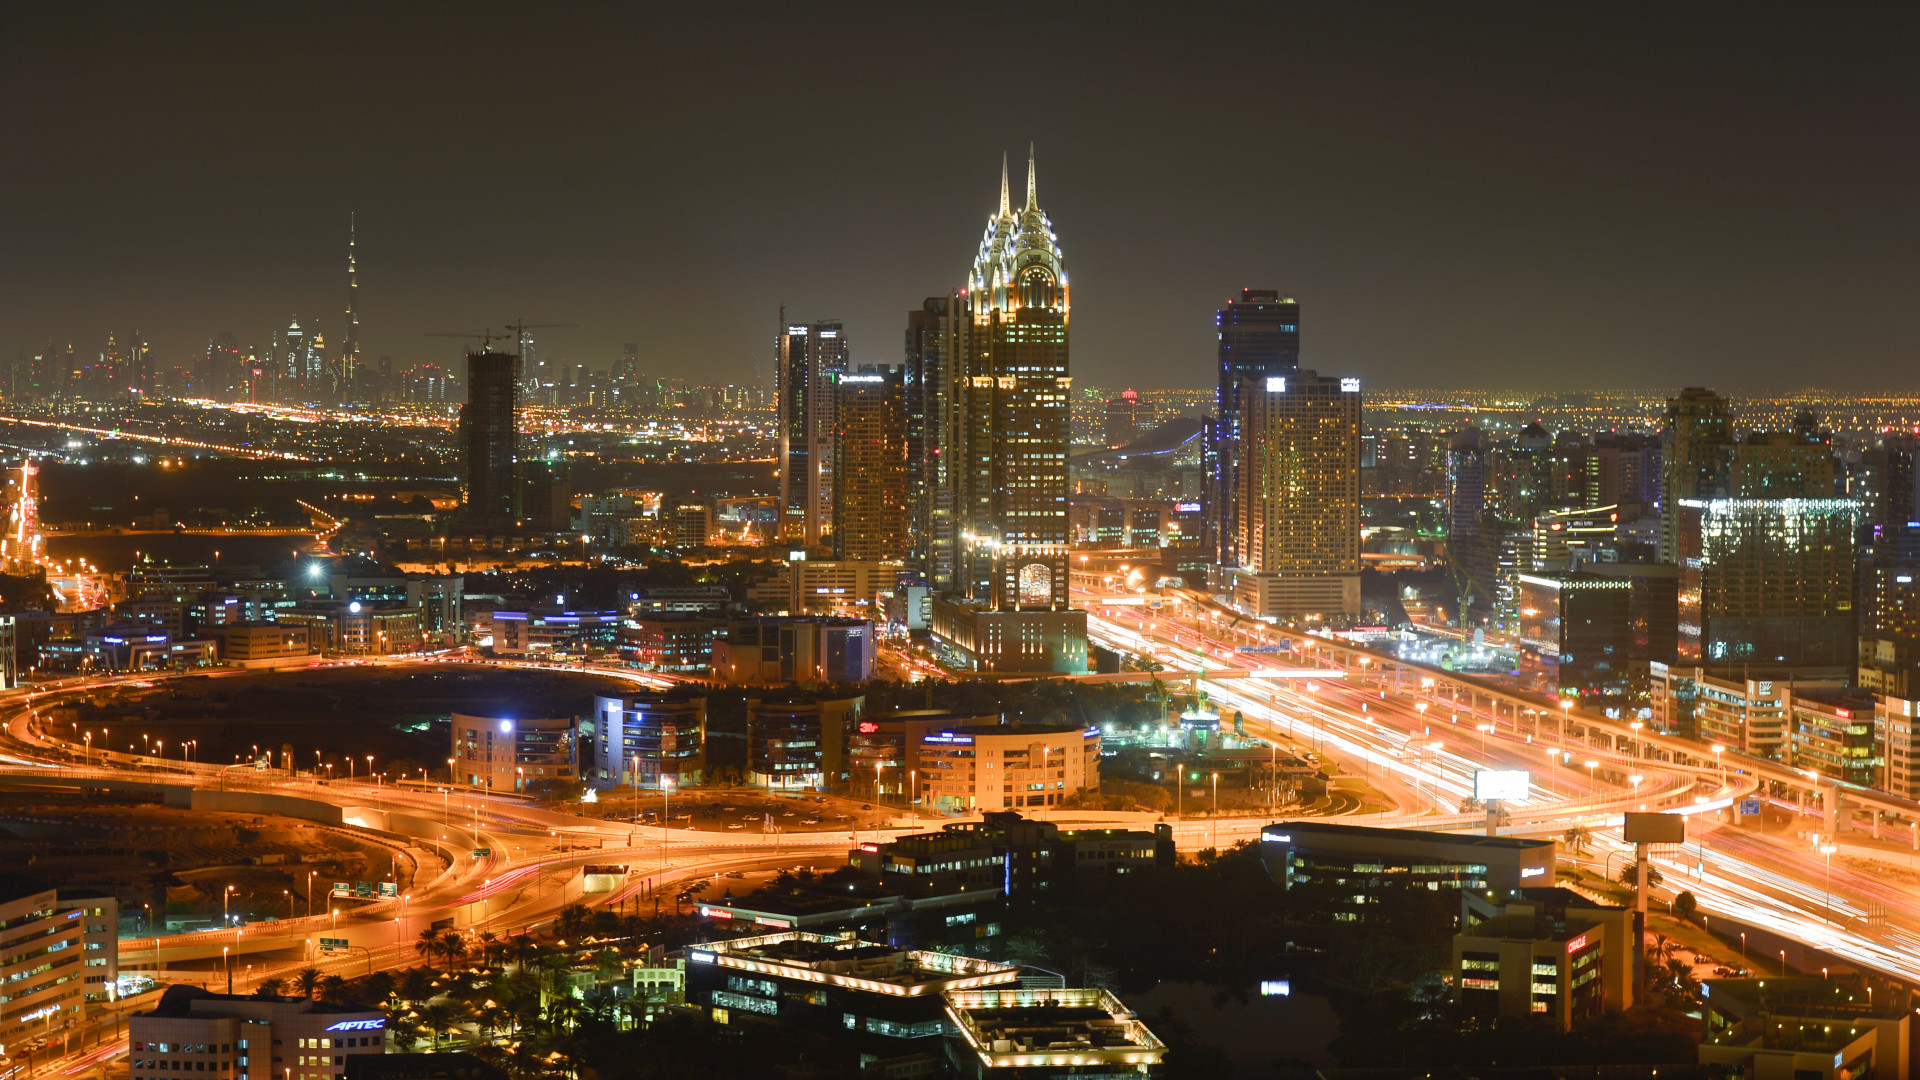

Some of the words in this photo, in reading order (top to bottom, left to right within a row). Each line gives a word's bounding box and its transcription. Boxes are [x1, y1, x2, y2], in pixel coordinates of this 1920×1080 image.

[861, 844, 878, 853] Canon
[709, 910, 733, 919] vodafone
[1568, 935, 1586, 954] ORACLE
[325, 1018, 386, 1032] APTEC
